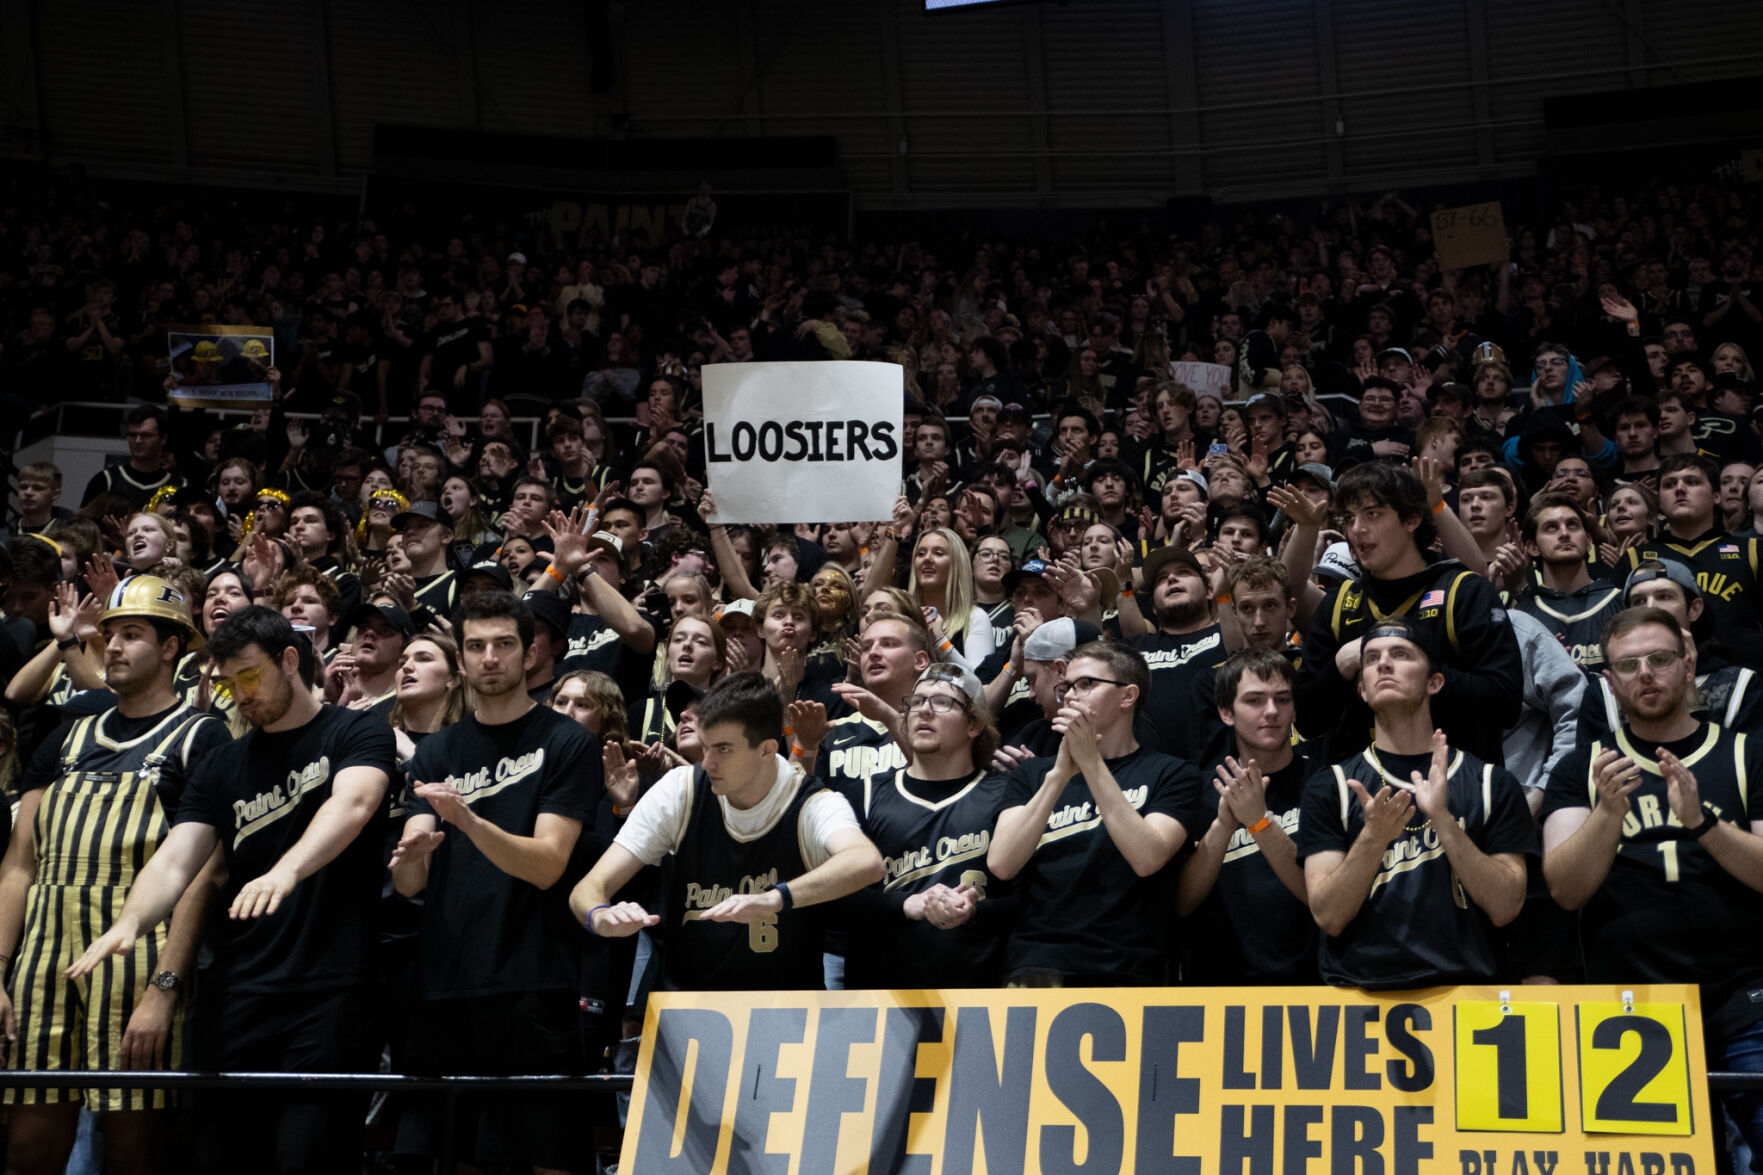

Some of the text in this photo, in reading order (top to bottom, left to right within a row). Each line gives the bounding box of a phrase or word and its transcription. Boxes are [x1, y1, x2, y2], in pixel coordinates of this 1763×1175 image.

[1174, 363, 1200, 384] OVE
[706, 420, 898, 462] LOOSIERS
[444, 748, 545, 795] aint Crew
[829, 740, 908, 780] PURDU
[232, 784, 287, 830] Paint
[882, 829, 990, 886] Paint Crew
[1382, 835, 1422, 870] aint
[1657, 840, 1680, 882] 1
[684, 882, 736, 910] Pain
[749, 912, 779, 953] 6
[1222, 1004, 1435, 1092] LIVES
[631, 1002, 1206, 1175] DEFENSE
[1218, 1105, 1435, 1175] HERE
